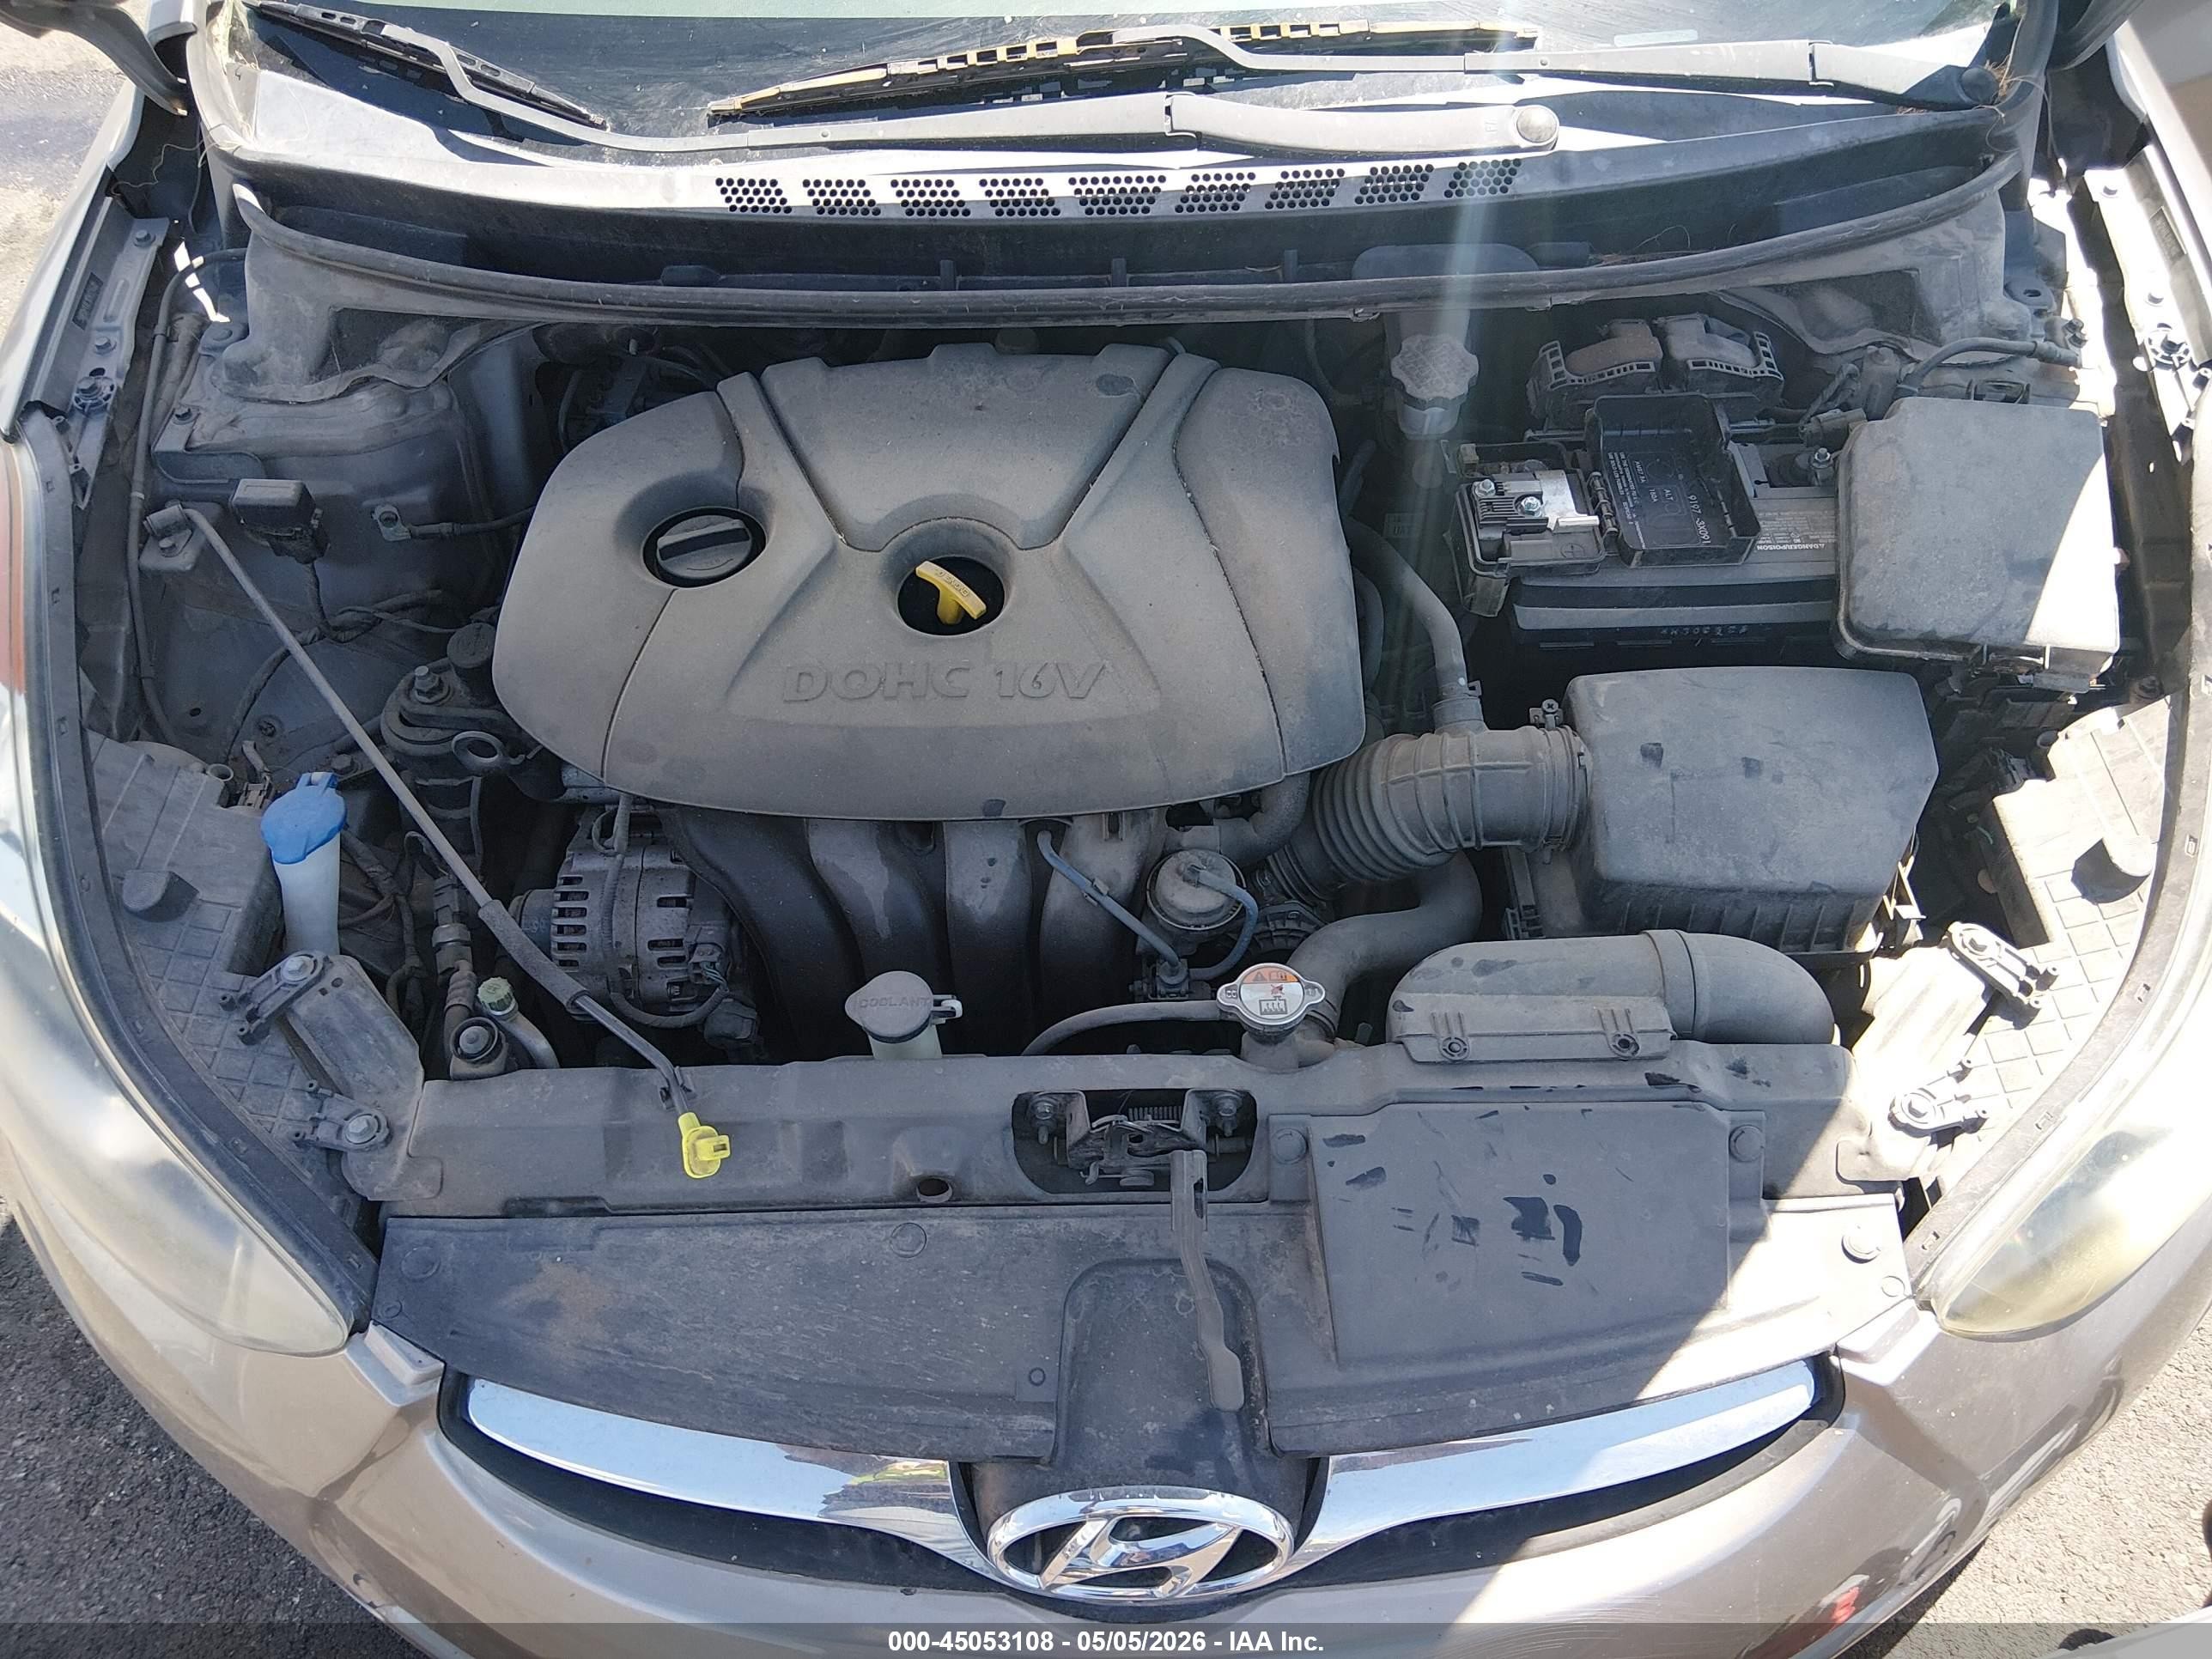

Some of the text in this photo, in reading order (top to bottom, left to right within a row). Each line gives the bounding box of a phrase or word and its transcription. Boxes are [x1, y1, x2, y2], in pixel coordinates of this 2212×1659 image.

[1663, 489, 1674, 501] ALT
[782, 661, 1107, 702] DOHC 16V
[859, 996, 930, 1008] COOLANT
